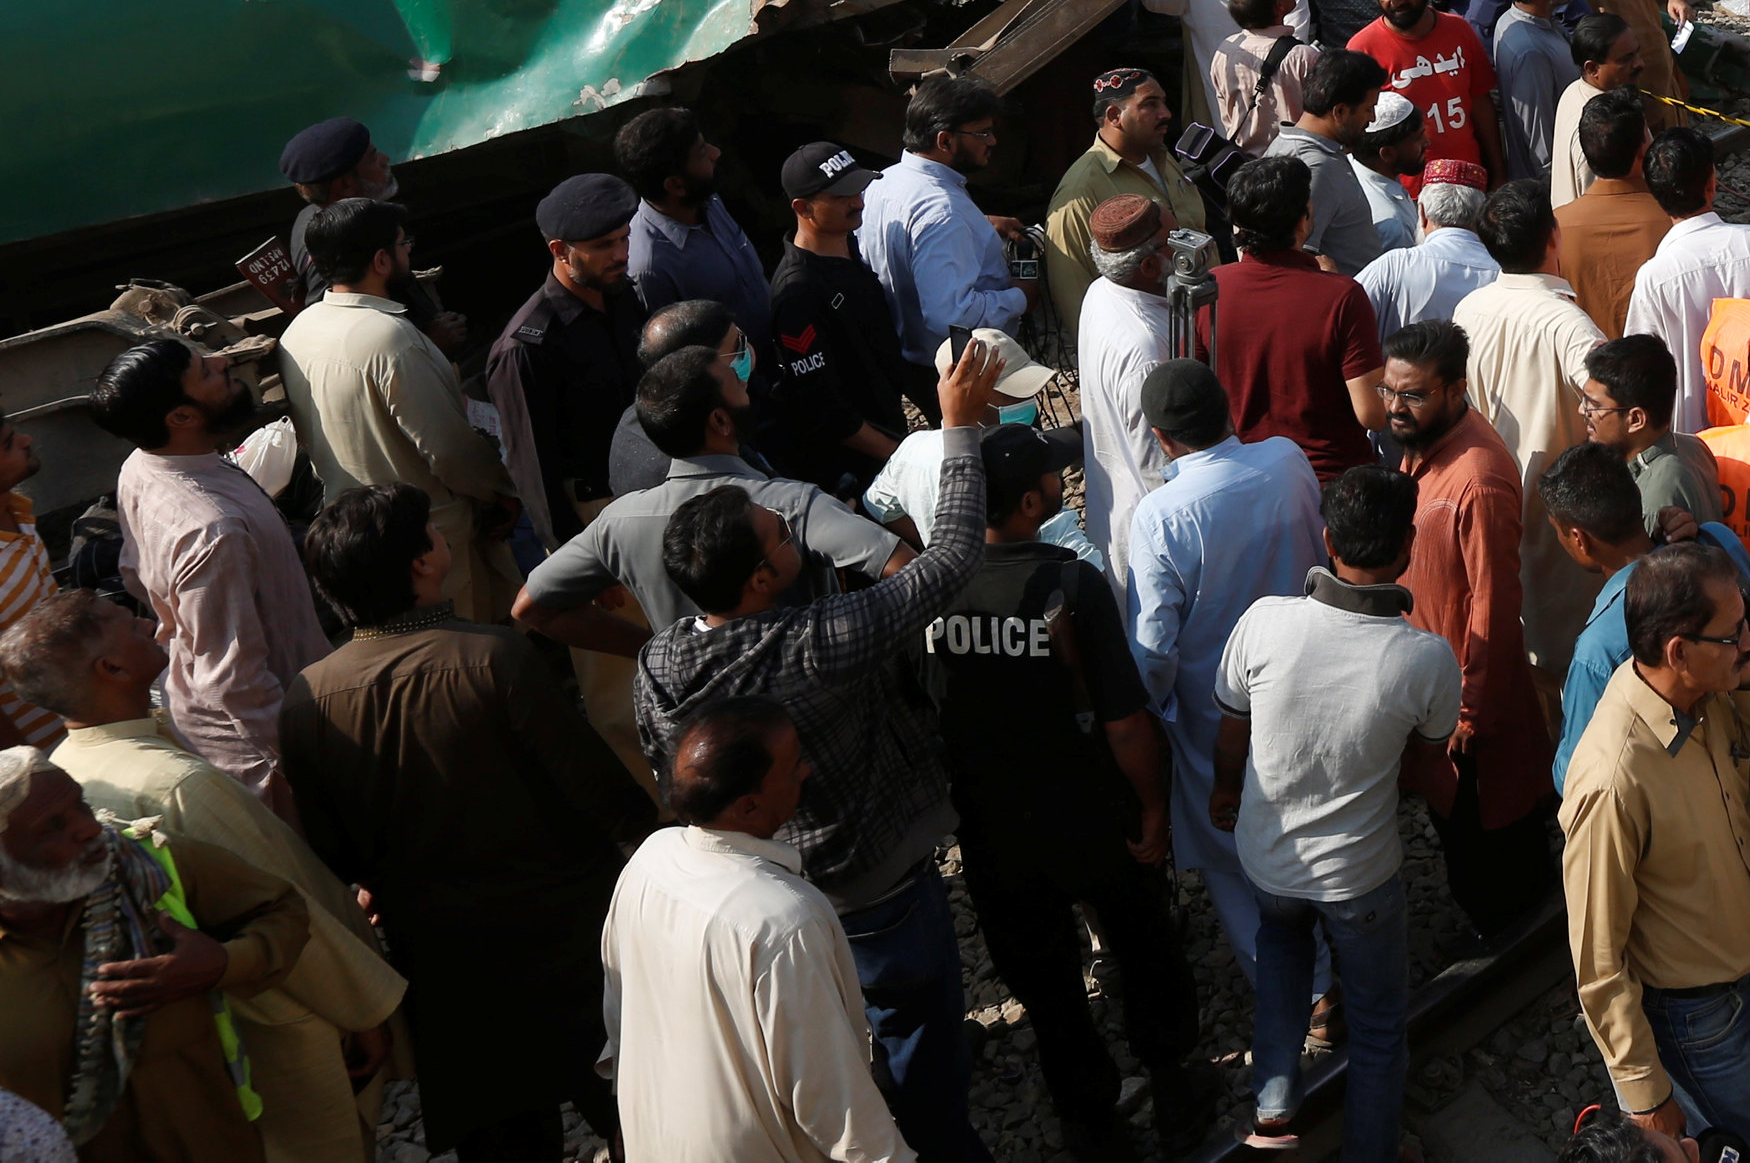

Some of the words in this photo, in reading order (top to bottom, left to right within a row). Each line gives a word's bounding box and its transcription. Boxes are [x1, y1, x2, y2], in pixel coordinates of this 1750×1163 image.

[818, 149, 856, 179] POLI
[257, 258, 290, 285] 12439
[1709, 345, 1750, 400] DM
[925, 614, 1050, 657] POLICE
